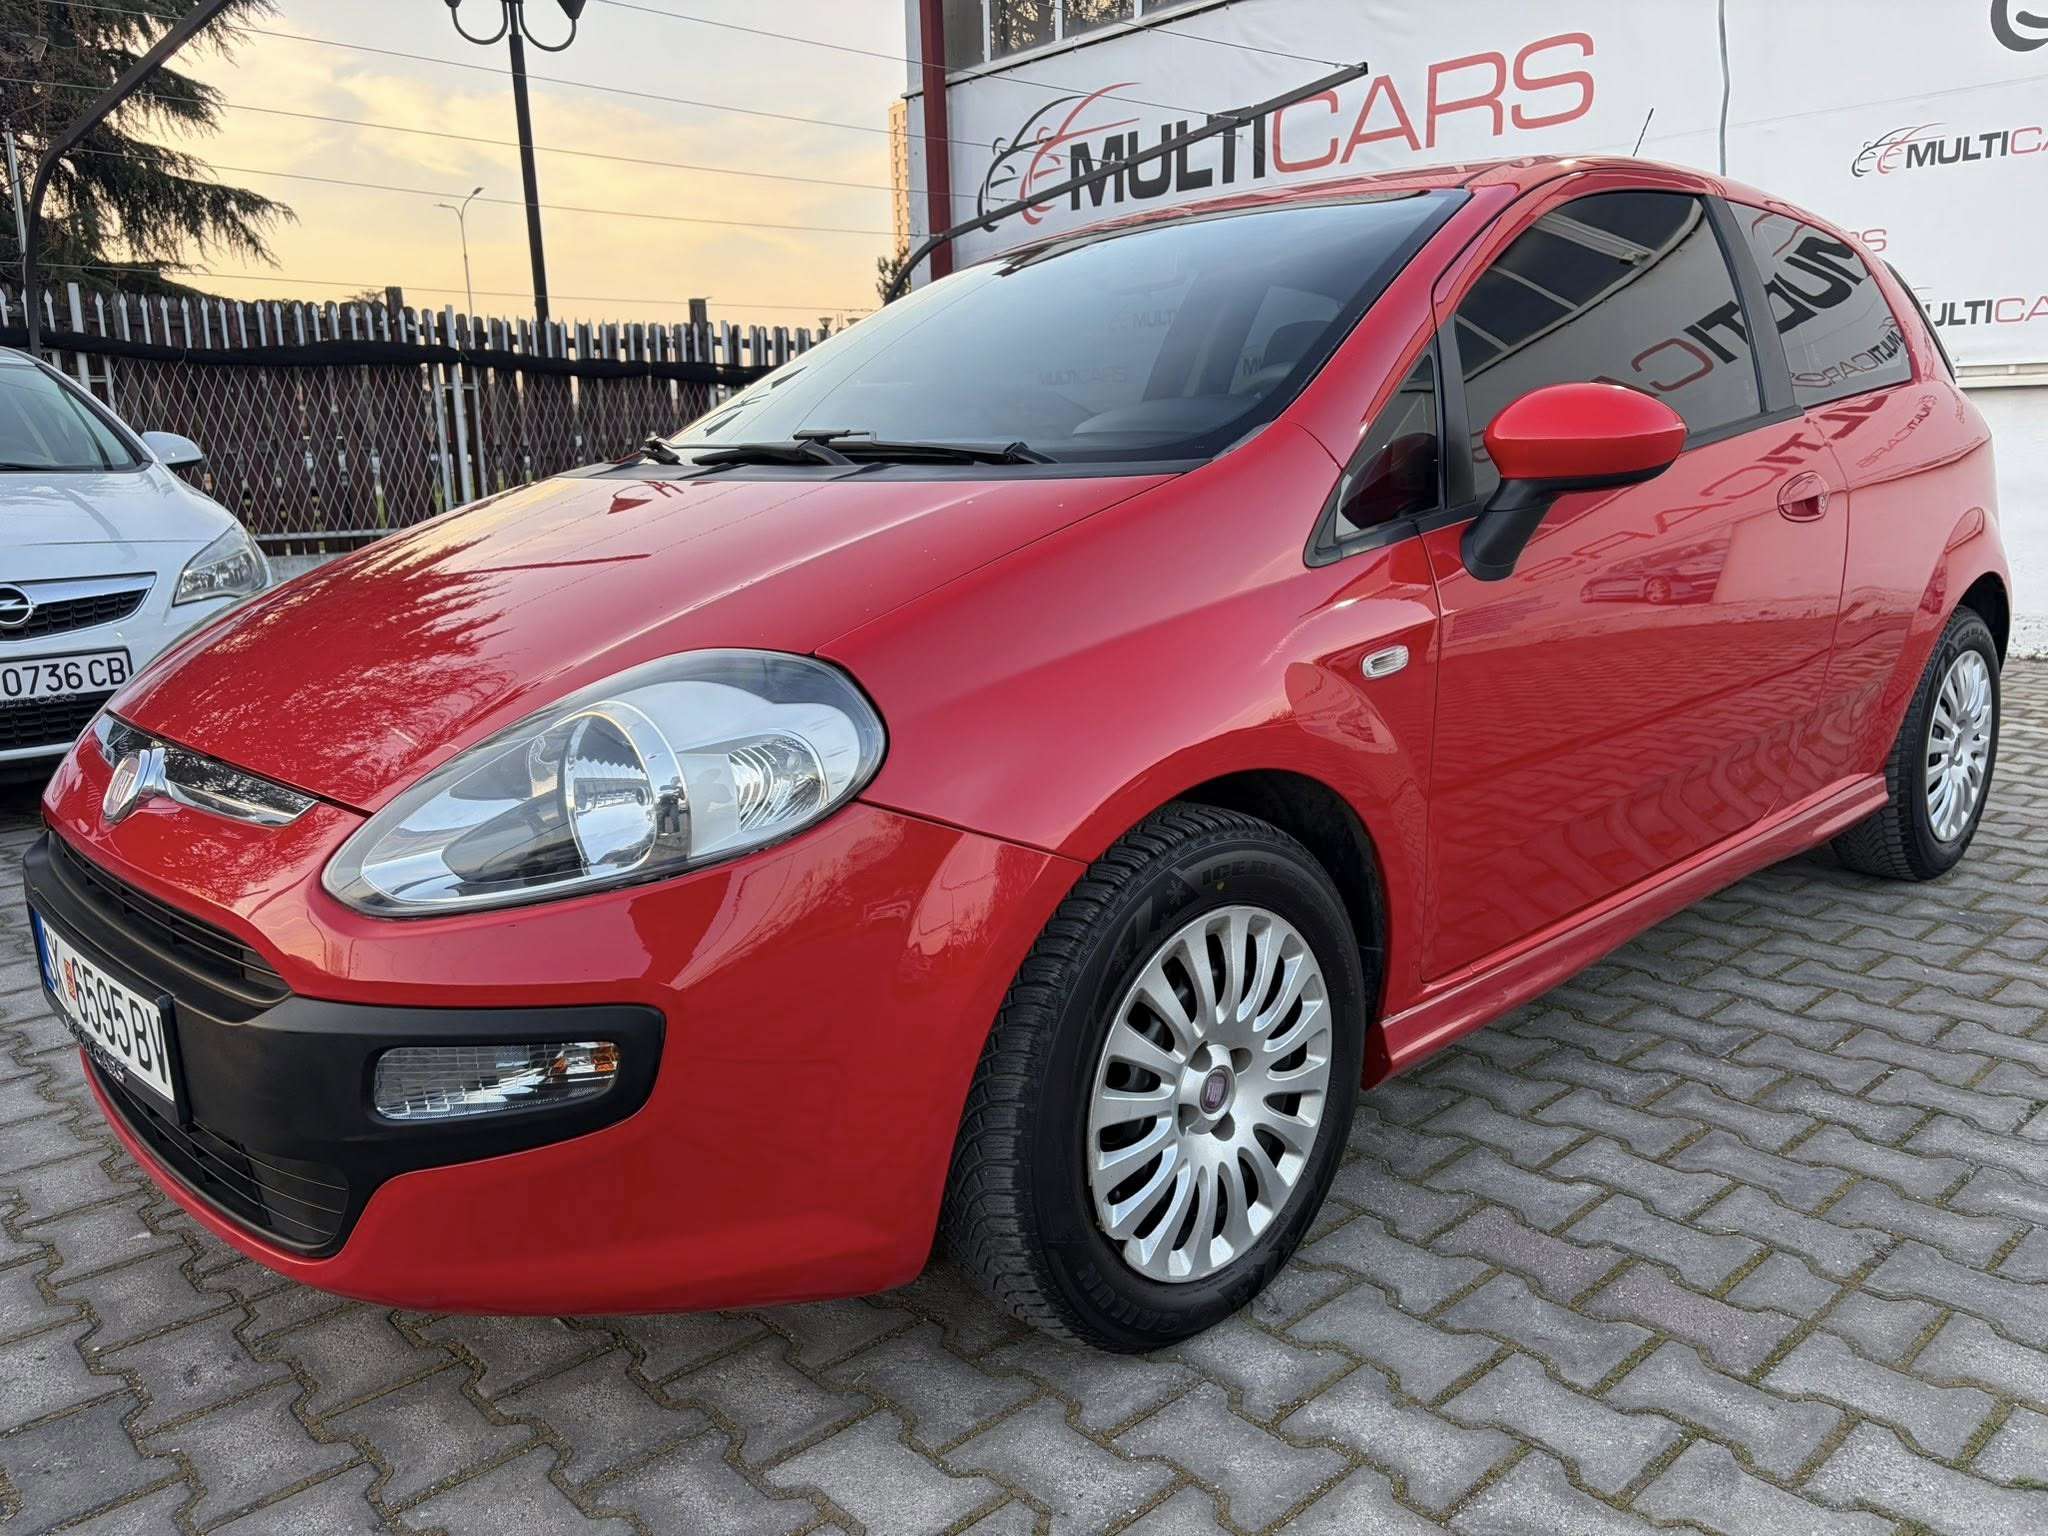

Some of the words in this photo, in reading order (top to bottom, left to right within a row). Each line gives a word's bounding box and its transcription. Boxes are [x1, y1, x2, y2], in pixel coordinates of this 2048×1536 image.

[1069, 32, 1595, 212] MULTICARS
[1905, 126, 2048, 169] MULTIC
[1924, 295, 2048, 328] ULTICA
[1, 662, 84, 697] 0736
[88, 656, 127, 687] CB
[71, 956, 132, 1058] 6595
[128, 996, 169, 1084] BV
